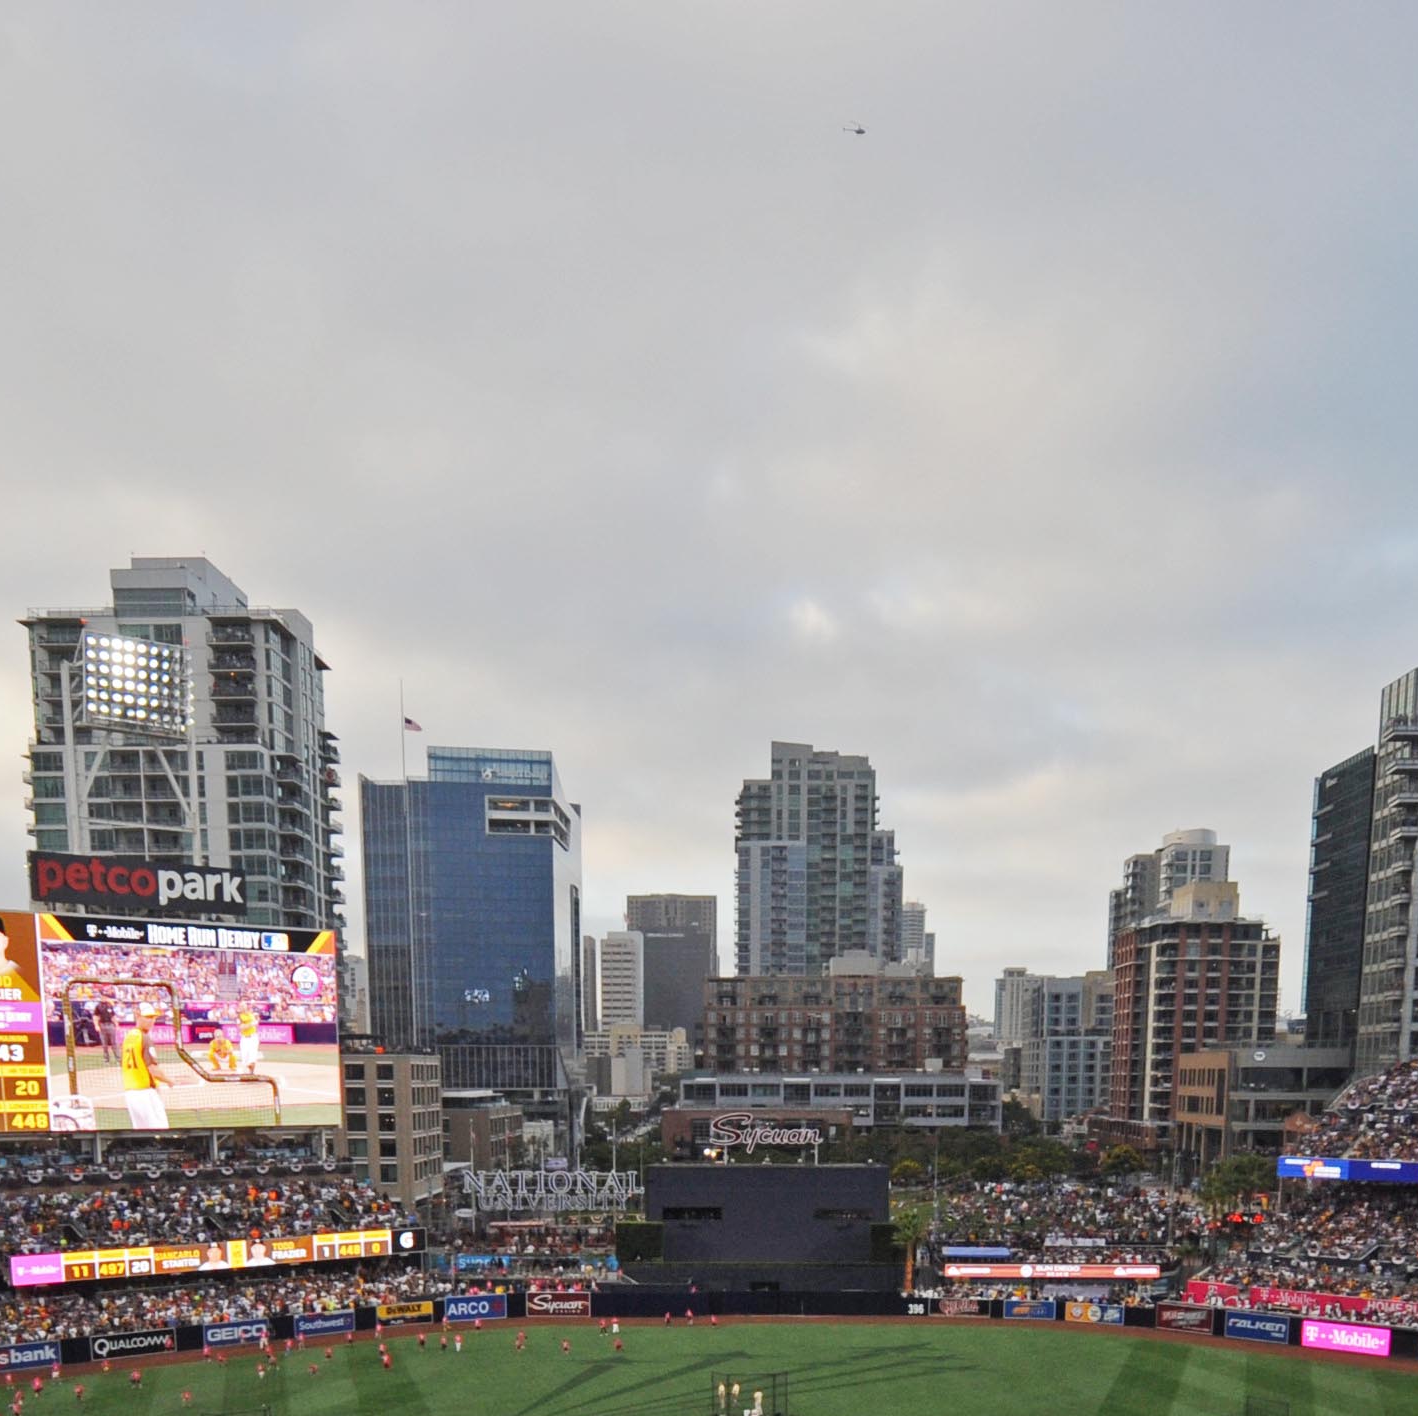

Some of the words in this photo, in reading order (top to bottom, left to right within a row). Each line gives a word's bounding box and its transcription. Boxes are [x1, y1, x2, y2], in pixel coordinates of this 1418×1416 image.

[147, 924, 186, 946] HOME
[188, 926, 217, 947] RUN
[14, 1080, 40, 1096] 20
[11, 1113, 49, 1129] 448
[709, 1112, 824, 1154] Sycuan
[462, 1169, 639, 1195] NATIONAL
[477, 1191, 629, 1212] UNIVERSITY
[70, 1265, 90, 1278] 11
[99, 1262, 126, 1276] 497
[447, 1301, 490, 1317] ARCO
[530, 1294, 584, 1313] Sycuan
[907, 1303, 925, 1315] 396
[298, 1317, 344, 1331] Southwest
[1228, 1318, 1287, 1333] FALKEN
[207, 1326, 268, 1343] GEICO
